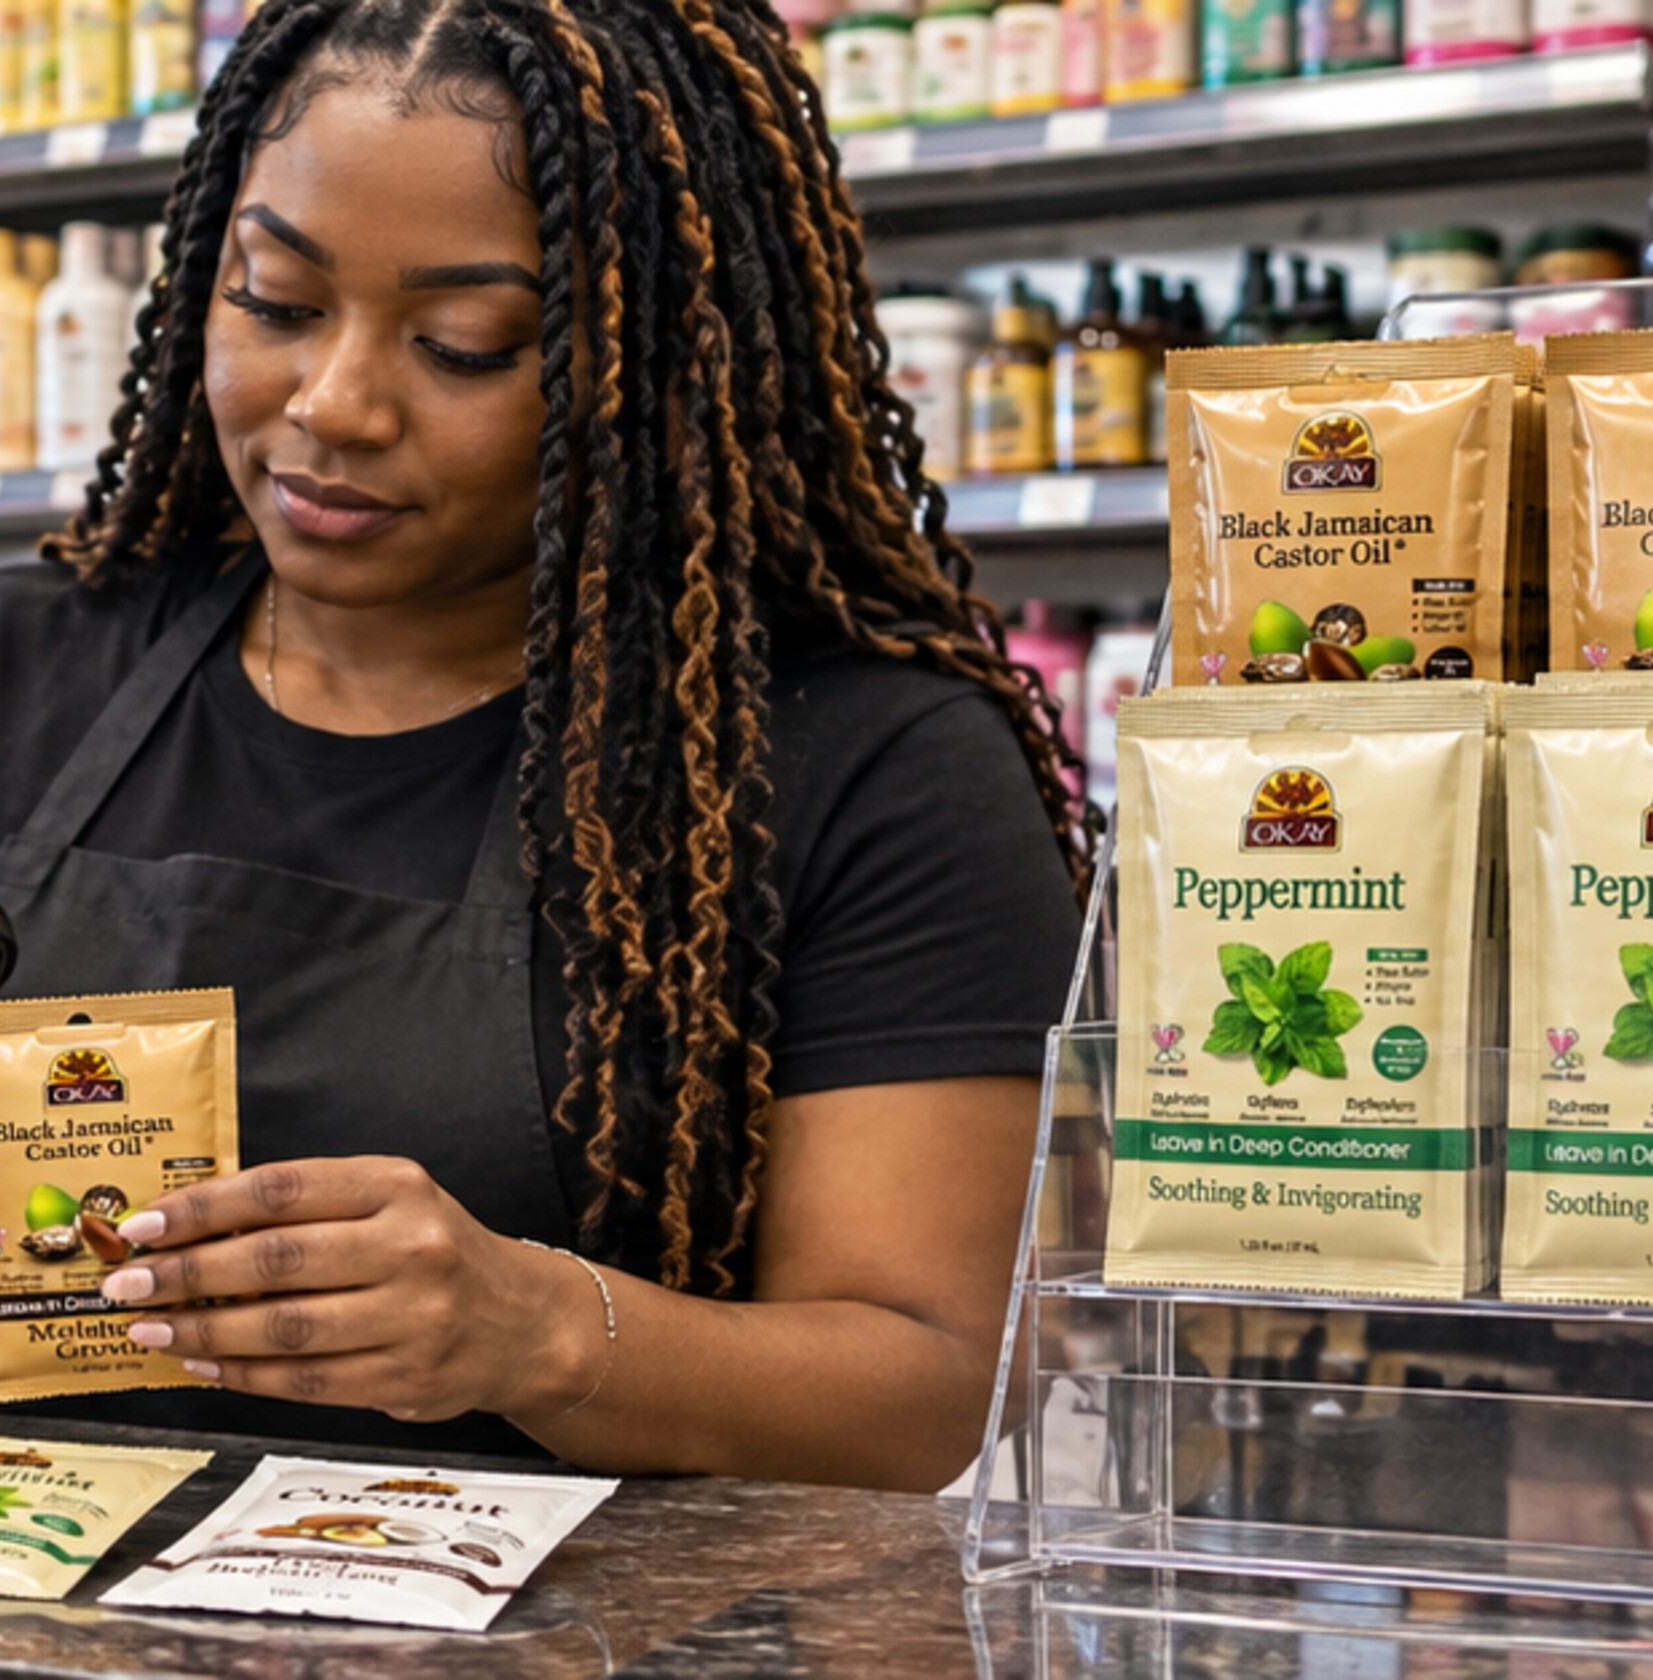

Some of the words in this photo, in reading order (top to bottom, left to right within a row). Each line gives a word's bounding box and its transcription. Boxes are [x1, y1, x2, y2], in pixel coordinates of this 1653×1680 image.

[1292, 463, 1371, 487] OKAY
[1219, 511, 1292, 540] Black
[1298, 509, 1434, 537] Jamaican
[1254, 544, 1345, 569] Castor
[1173, 865, 1406, 921] Peppermint
[60, 1114, 174, 1139] Jamaican
[1208, 1133, 1226, 1153] in
[1229, 1134, 1284, 1158] Deep
[1607, 1144, 1627, 1164] in
[1148, 1175, 1247, 1211] Soothing
[1251, 1180, 1271, 1206] &
[1277, 1182, 1423, 1219] Invigorating
[1545, 1189, 1650, 1225] Soothing
